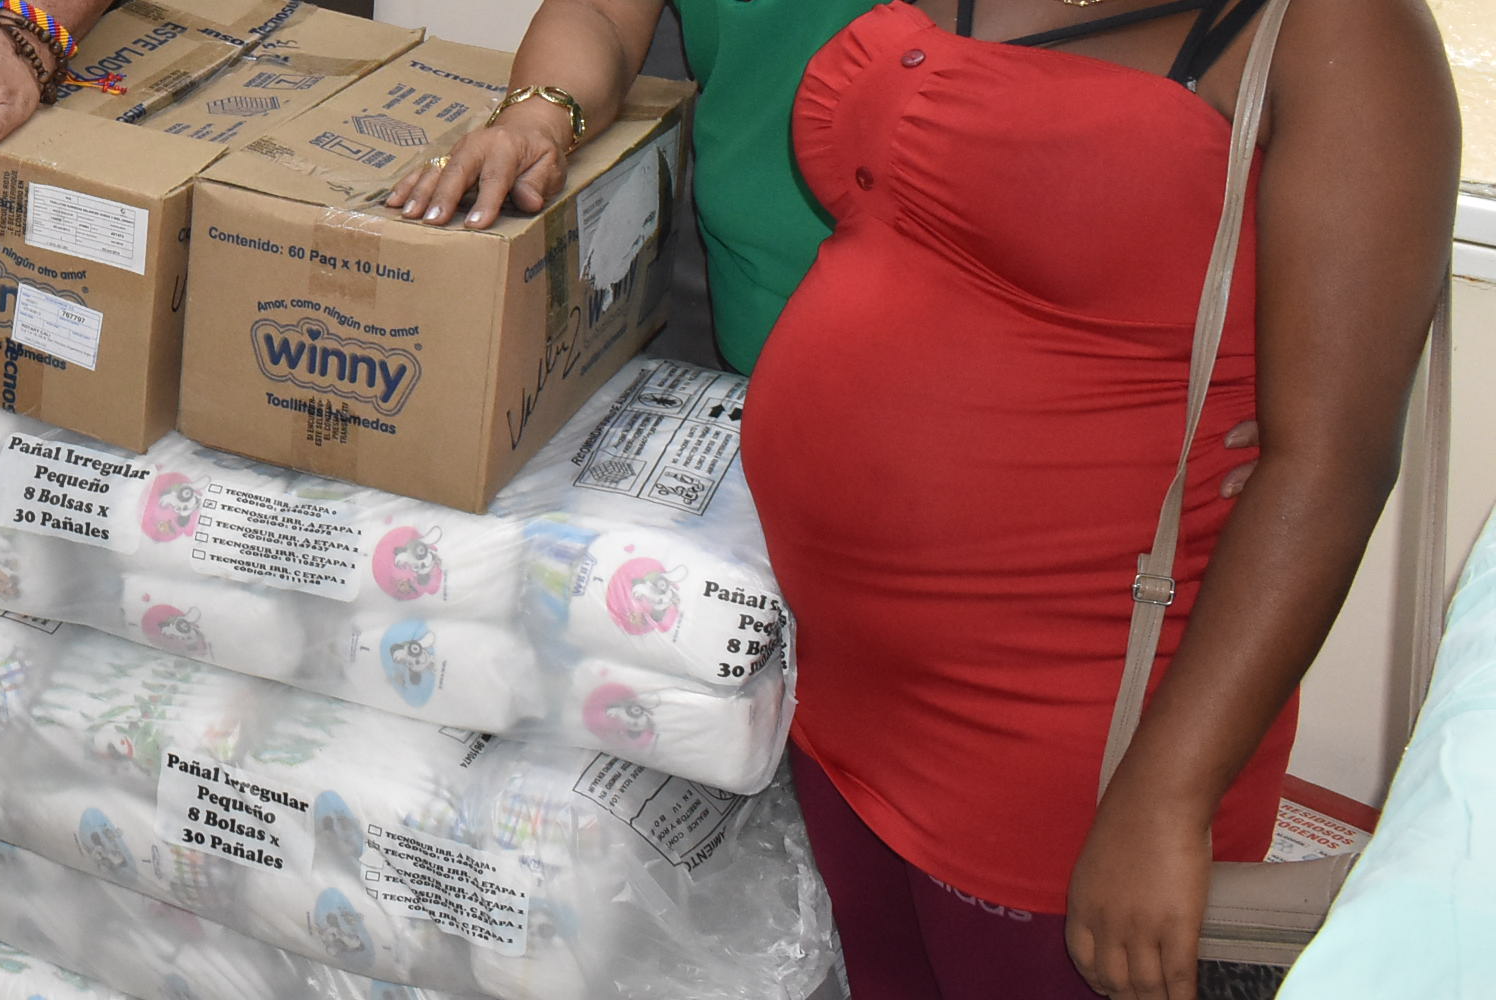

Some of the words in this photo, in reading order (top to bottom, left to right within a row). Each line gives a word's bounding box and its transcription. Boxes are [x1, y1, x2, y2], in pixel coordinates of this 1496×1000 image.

[143, 21, 188, 52] ESTE
[85, 40, 146, 78] LADO
[2, 246, 36, 272] ningún
[37, 264, 58, 279] otro
[60, 270, 87, 281] amor
[208, 226, 283, 255] Contenido:
[288, 246, 304, 259] 60
[310, 250, 337, 268] Paq
[341, 259, 350, 270] x
[355, 260, 371, 273] 10
[376, 263, 414, 283] Unid.
[257, 299, 287, 313] Amor,
[290, 299, 321, 311] como
[324, 305, 360, 330] ningún
[364, 324, 386, 336] otro
[390, 326, 419, 337] amor
[263, 328, 407, 404] winny
[8, 436, 61, 461] Pañal
[65, 449, 150, 480] Irregular
[34, 465, 110, 494] Pequeño
[23, 486, 36, 500] 8
[37, 488, 93, 514] Bolsas
[226, 488, 271, 503] TECNOSUR
[274, 499, 291, 509] IRR.
[302, 504, 329, 515] ETAPA
[236, 497, 277, 512] CODIGO:
[13, 509, 36, 523] 30
[40, 511, 110, 540] Pañales
[221, 504, 279, 521] TECNOSUR
[282, 516, 304, 526] IRR.
[318, 523, 354, 534] ETAPA
[247, 516, 288, 528] CODIGO:
[216, 520, 275, 538] TECNOSUR
[278, 533, 300, 543] IRR.
[314, 539, 354, 552] ETAPA
[242, 532, 283, 545] CODIGO:
[212, 536, 272, 554] TECNOSUR
[275, 549, 299, 558] IRR.
[312, 555, 347, 568] ETAPA
[239, 549, 282, 561] CODIGO:
[209, 554, 266, 570] TECNOSUR
[269, 565, 291, 574] IRR.
[303, 571, 337, 583] ETAPA
[233, 565, 276, 577] CODIGO:
[703, 580, 767, 609] Pañal
[727, 639, 741, 653] 8
[717, 662, 745, 677] 30
[167, 753, 220, 782] Pañal
[223, 771, 309, 813] Irregular
[197, 785, 276, 824] Pequeño
[188, 806, 200, 821] 8
[204, 809, 266, 840] Bolsas
[270, 834, 280, 847] x
[1281, 804, 1357, 837] RESIDUOS
[182, 828, 205, 844] 30
[210, 834, 283, 869] Pañales
[386, 831, 433, 852] TECNOSUR
[436, 848, 454, 857] IRR.
[383, 848, 444, 872] TECNOSUR
[448, 867, 471, 878] IRR.
[481, 881, 516, 896] ETAPA
[444, 883, 468, 893] IRR.
